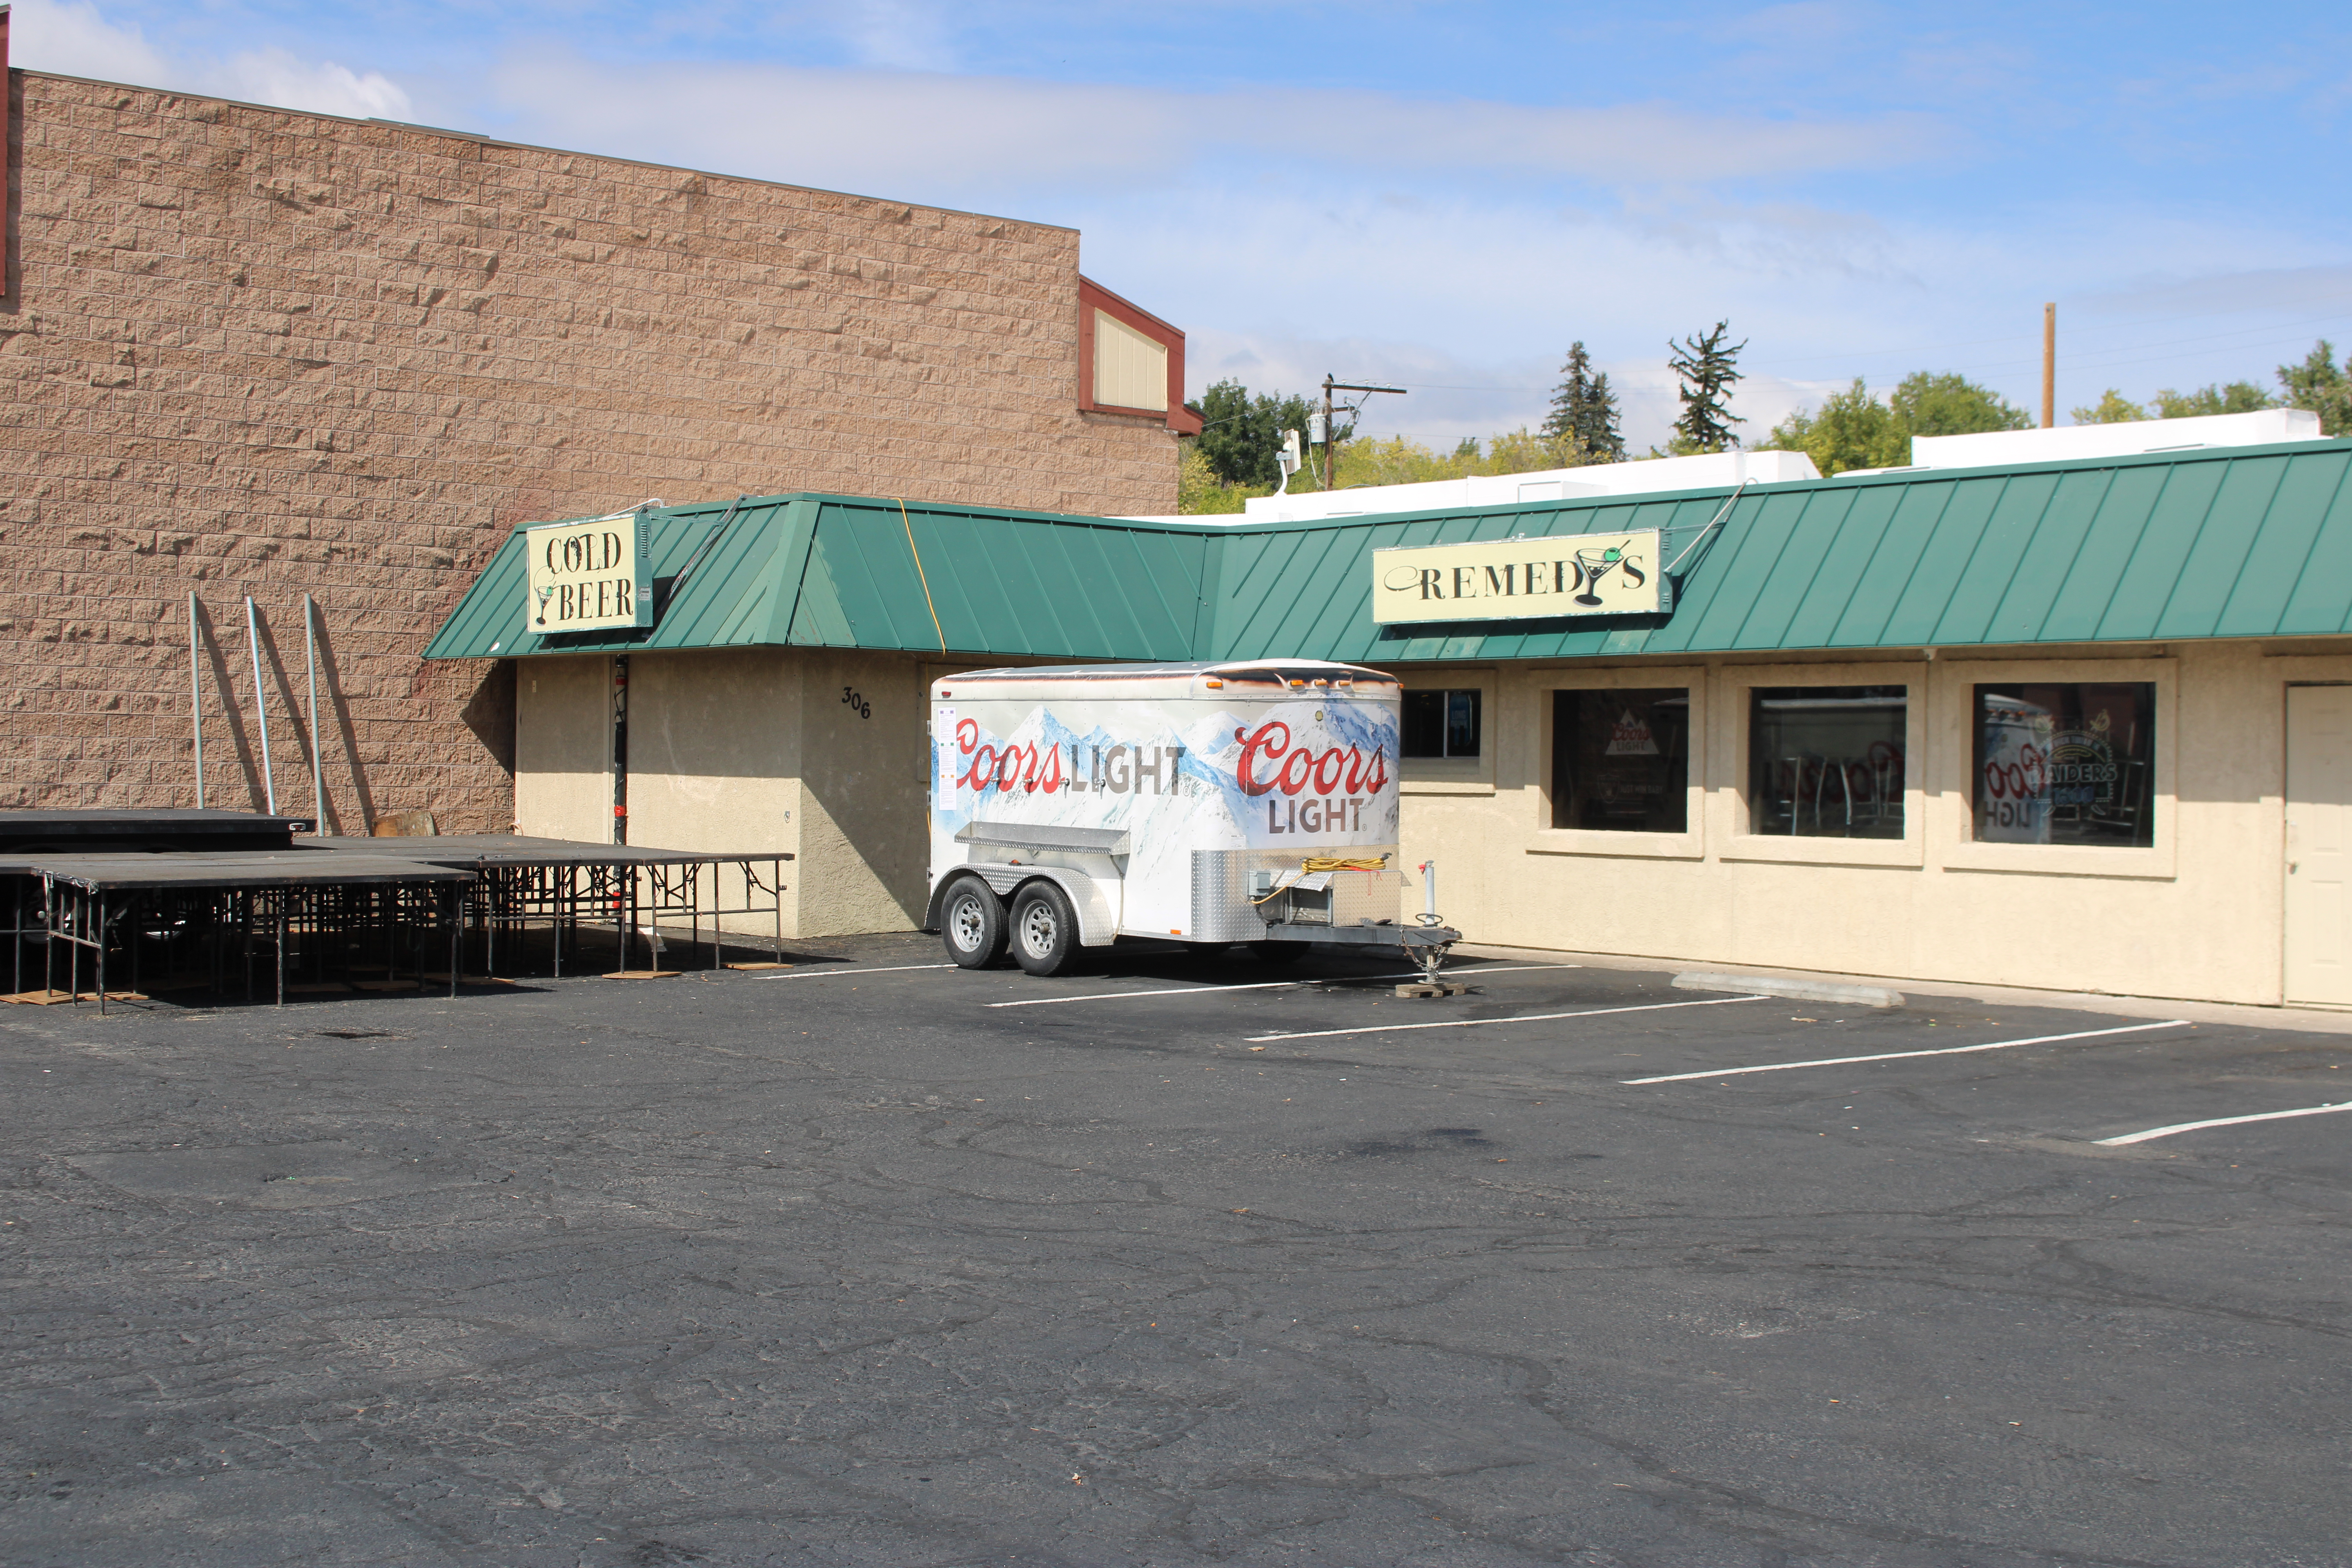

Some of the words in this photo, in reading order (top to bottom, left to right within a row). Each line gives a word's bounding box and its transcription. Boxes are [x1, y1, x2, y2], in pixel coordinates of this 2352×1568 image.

[546, 532, 621, 574] COLD
[554, 579, 633, 621] BEER
[842, 686, 871, 719] 306
[1452, 710, 1466, 719] LONG
[1612, 722, 1650, 741] Coors
[1235, 722, 1388, 796] Coors
[1617, 741, 1646, 751] LIGHT
[2028, 763, 2118, 783] RAIDERS
